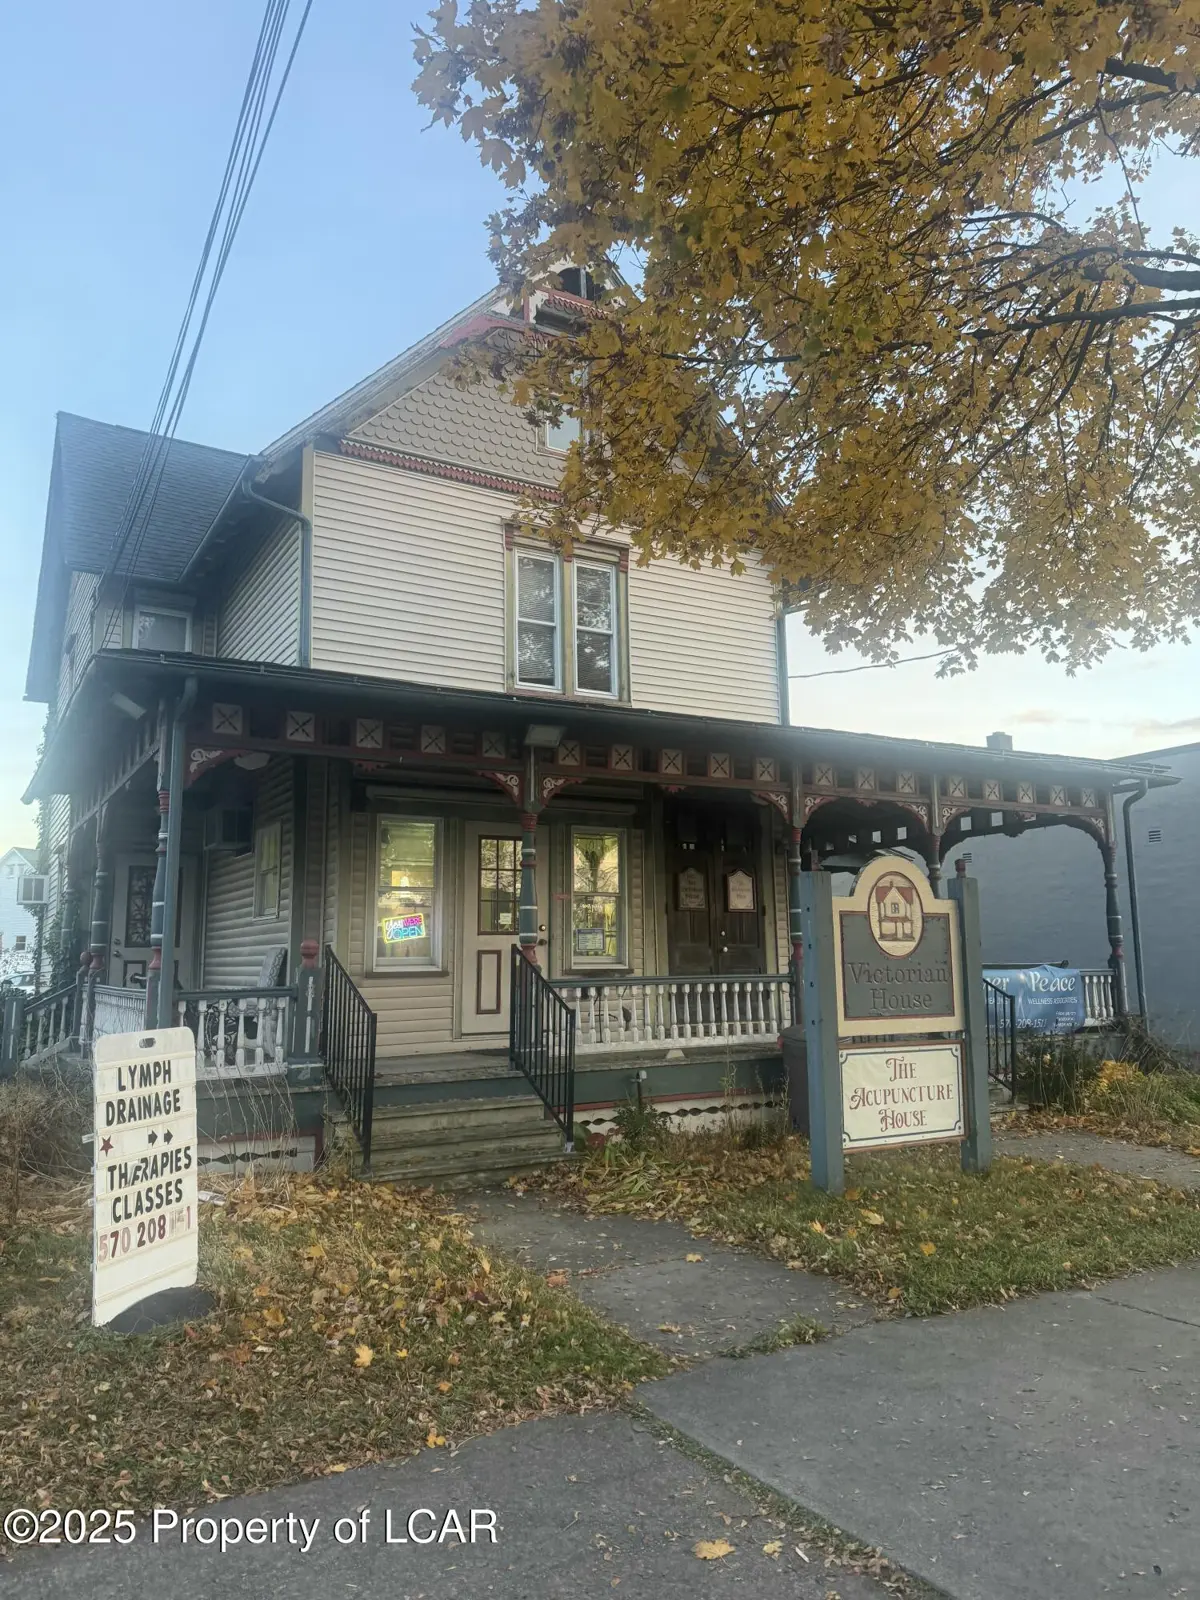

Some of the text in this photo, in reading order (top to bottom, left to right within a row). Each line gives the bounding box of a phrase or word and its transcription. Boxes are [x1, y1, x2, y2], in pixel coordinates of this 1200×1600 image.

[392, 925, 423, 939] OPEN
[847, 961, 947, 984] Victorian
[1028, 971, 1076, 992] Peace
[870, 987, 932, 1010] House
[117, 1059, 171, 1091] LYMPH
[105, 1088, 181, 1127] DRAINAGE
[107, 1145, 192, 1191] THERAPIES
[112, 1178, 182, 1223] CLASSES
[98, 1227, 131, 1262] 570
[137, 1214, 167, 1248] 208
